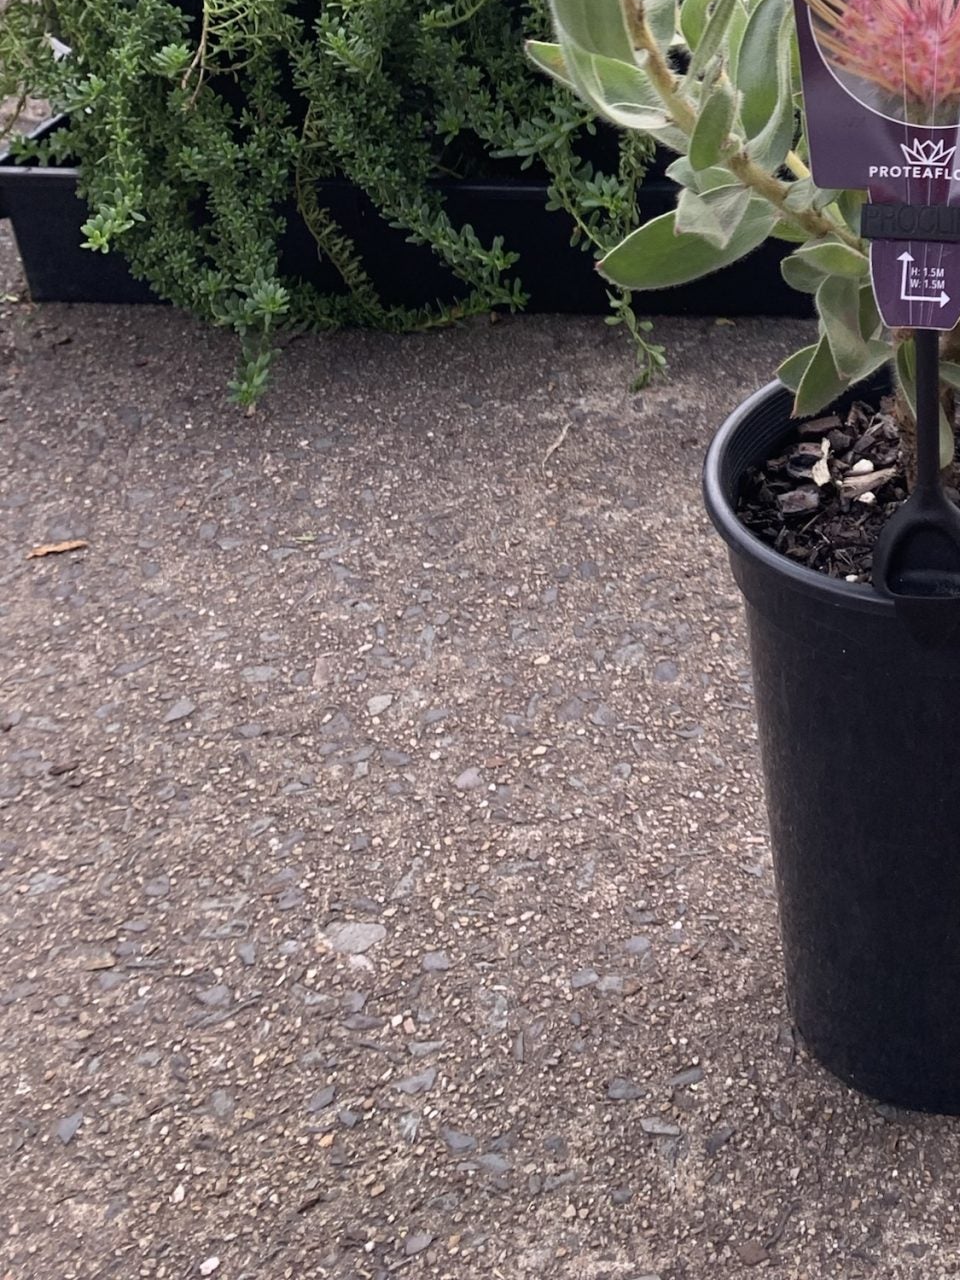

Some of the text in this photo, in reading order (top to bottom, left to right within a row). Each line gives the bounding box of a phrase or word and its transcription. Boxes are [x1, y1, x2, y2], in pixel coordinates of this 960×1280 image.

[911, 267, 945, 278] H: 1.5M
[910, 279, 945, 289] W: 1.5M
